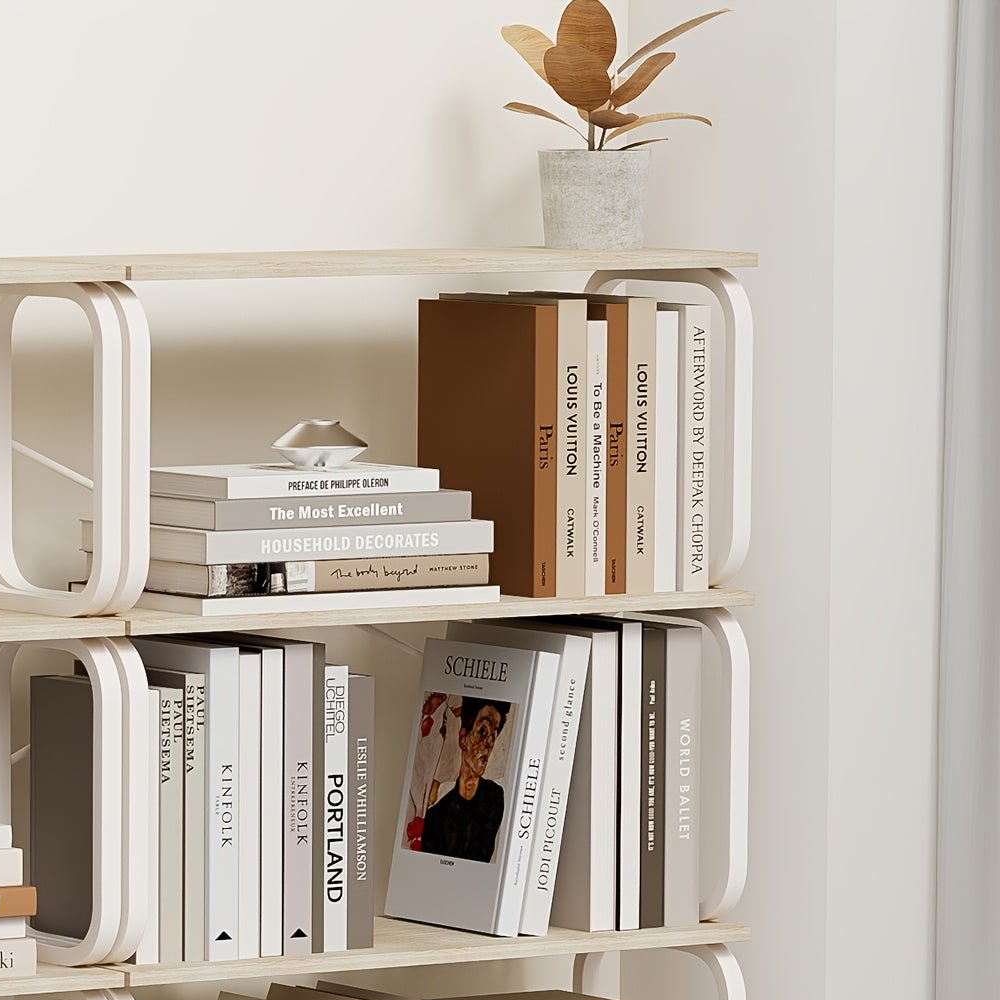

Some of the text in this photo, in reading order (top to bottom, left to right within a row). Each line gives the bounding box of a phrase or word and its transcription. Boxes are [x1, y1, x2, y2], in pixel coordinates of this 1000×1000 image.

[593, 382, 602, 398] To
[593, 402, 602, 420] Be
[593, 422, 600, 430] a
[540, 424, 554, 470] Paris
[566, 366, 578, 558] LOUIS VUITTON CATWALK
[593, 434, 602, 489] Machine
[691, 325, 706, 575] AFTERWORD BY DEEPAK CHOPRA
[261, 532, 440, 554] HOUSEHOLD DECORATES
[269, 502, 404, 521] The Most Excellent
[444, 655, 508, 682] SCHIELE
[162, 700, 170, 784] SIETSEMA
[174, 700, 182, 743] PAUL
[326, 678, 336, 743] UCHITEL
[336, 686, 345, 734] DIEGO
[558, 678, 577, 761] second glance
[222, 764, 232, 848] KINFOLK
[297, 762, 308, 845] KINFOLK
[356, 738, 367, 881] LESLIE WHILLIAMSON
[518, 756, 542, 840] SCHIELE
[678, 718, 692, 840] WORLD BALLET
[327, 774, 344, 903] PORTLAND
[536, 786, 562, 892] JODI PICOULT
